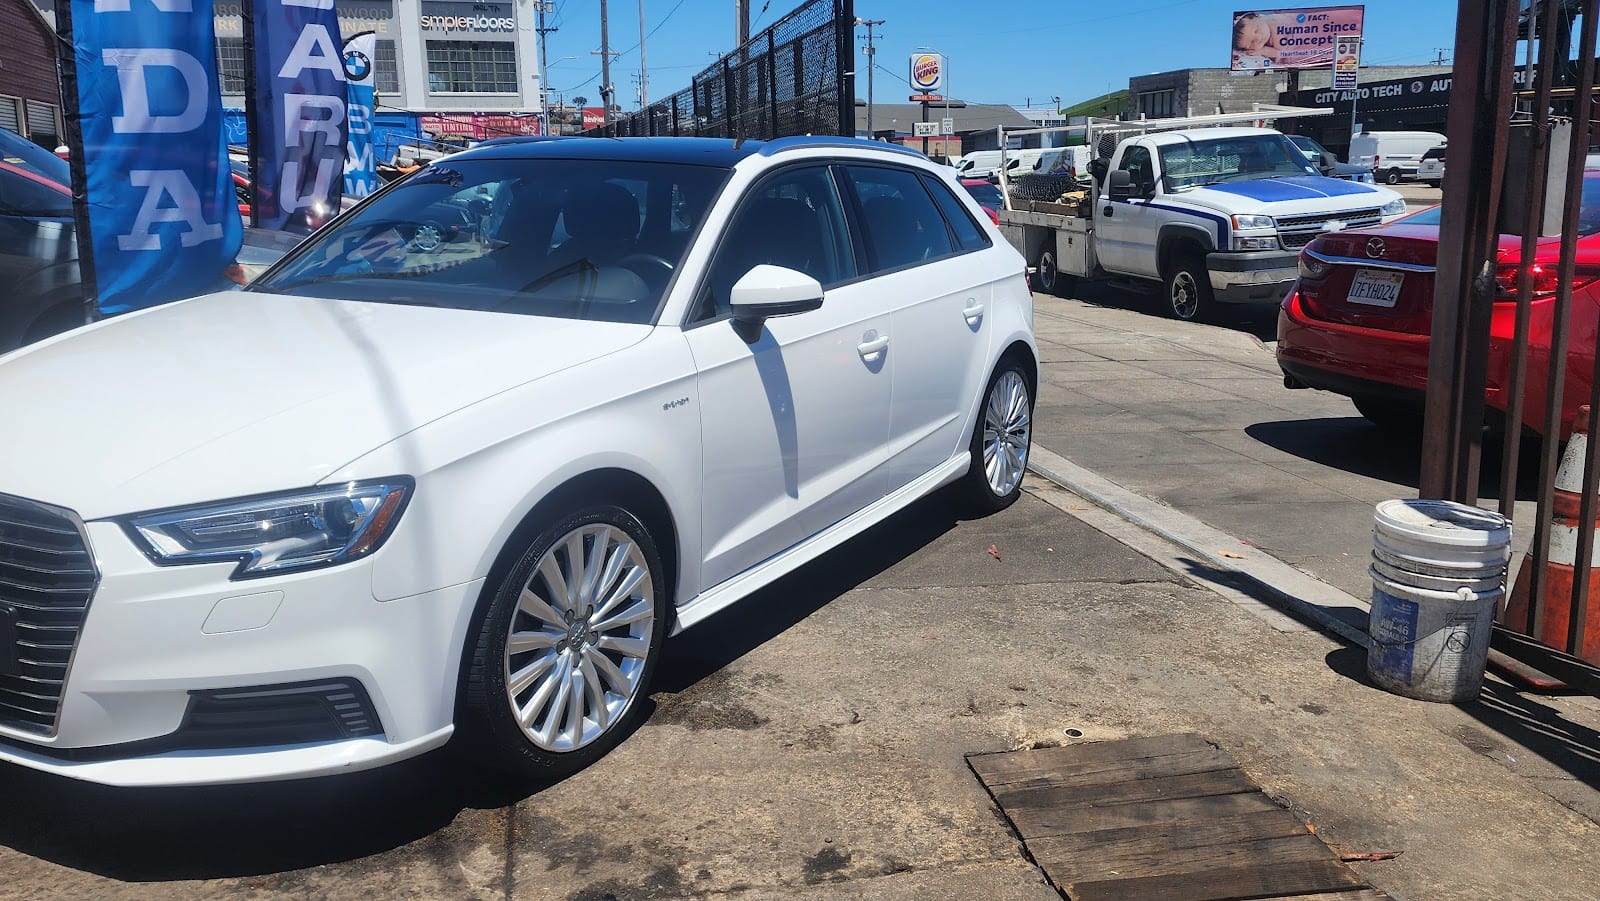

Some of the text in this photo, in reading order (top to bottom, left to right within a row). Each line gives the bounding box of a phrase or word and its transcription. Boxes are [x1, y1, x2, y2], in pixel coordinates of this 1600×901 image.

[1277, 21, 1356, 35] Human Since
[1279, 35, 1333, 47] Concept
[916, 61, 937, 71] BURGER
[917, 67, 938, 80] KING
[1315, 92, 1339, 103] CITY
[1341, 88, 1370, 101] AUTO
[1372, 84, 1403, 98] TECH
[1430, 79, 1452, 92] AUT
[278, 0, 347, 214] ARU
[94, 0, 224, 250] DA
[442, 123, 474, 132] TINTING
[1355, 282, 1396, 301] 7FYH024
